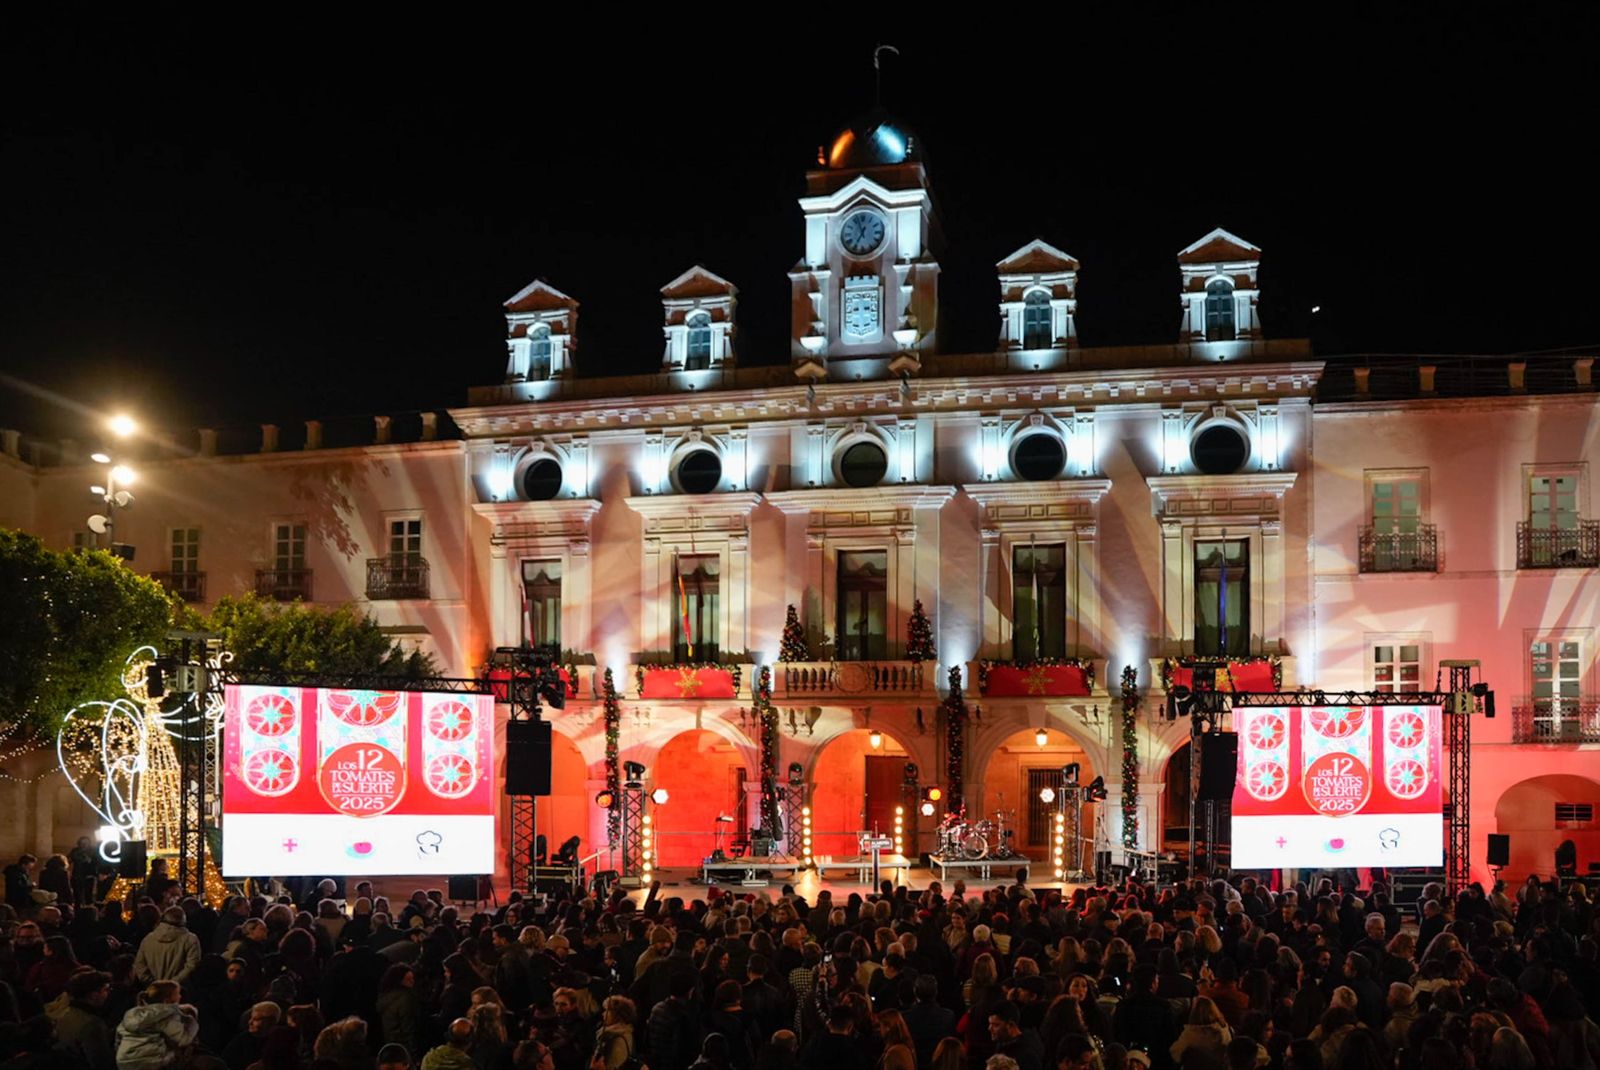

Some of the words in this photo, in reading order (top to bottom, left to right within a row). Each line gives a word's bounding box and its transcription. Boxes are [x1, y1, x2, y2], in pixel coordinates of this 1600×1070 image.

[338, 761, 356, 770] LOS
[356, 749, 384, 770] 12
[1332, 758, 1354, 777] 12
[329, 770, 396, 783] TOMATES
[1311, 777, 1363, 787] TOMATES
[341, 782, 395, 794] SUERTE
[340, 796, 385, 810] 2025
[1319, 799, 1354, 811] 2025
